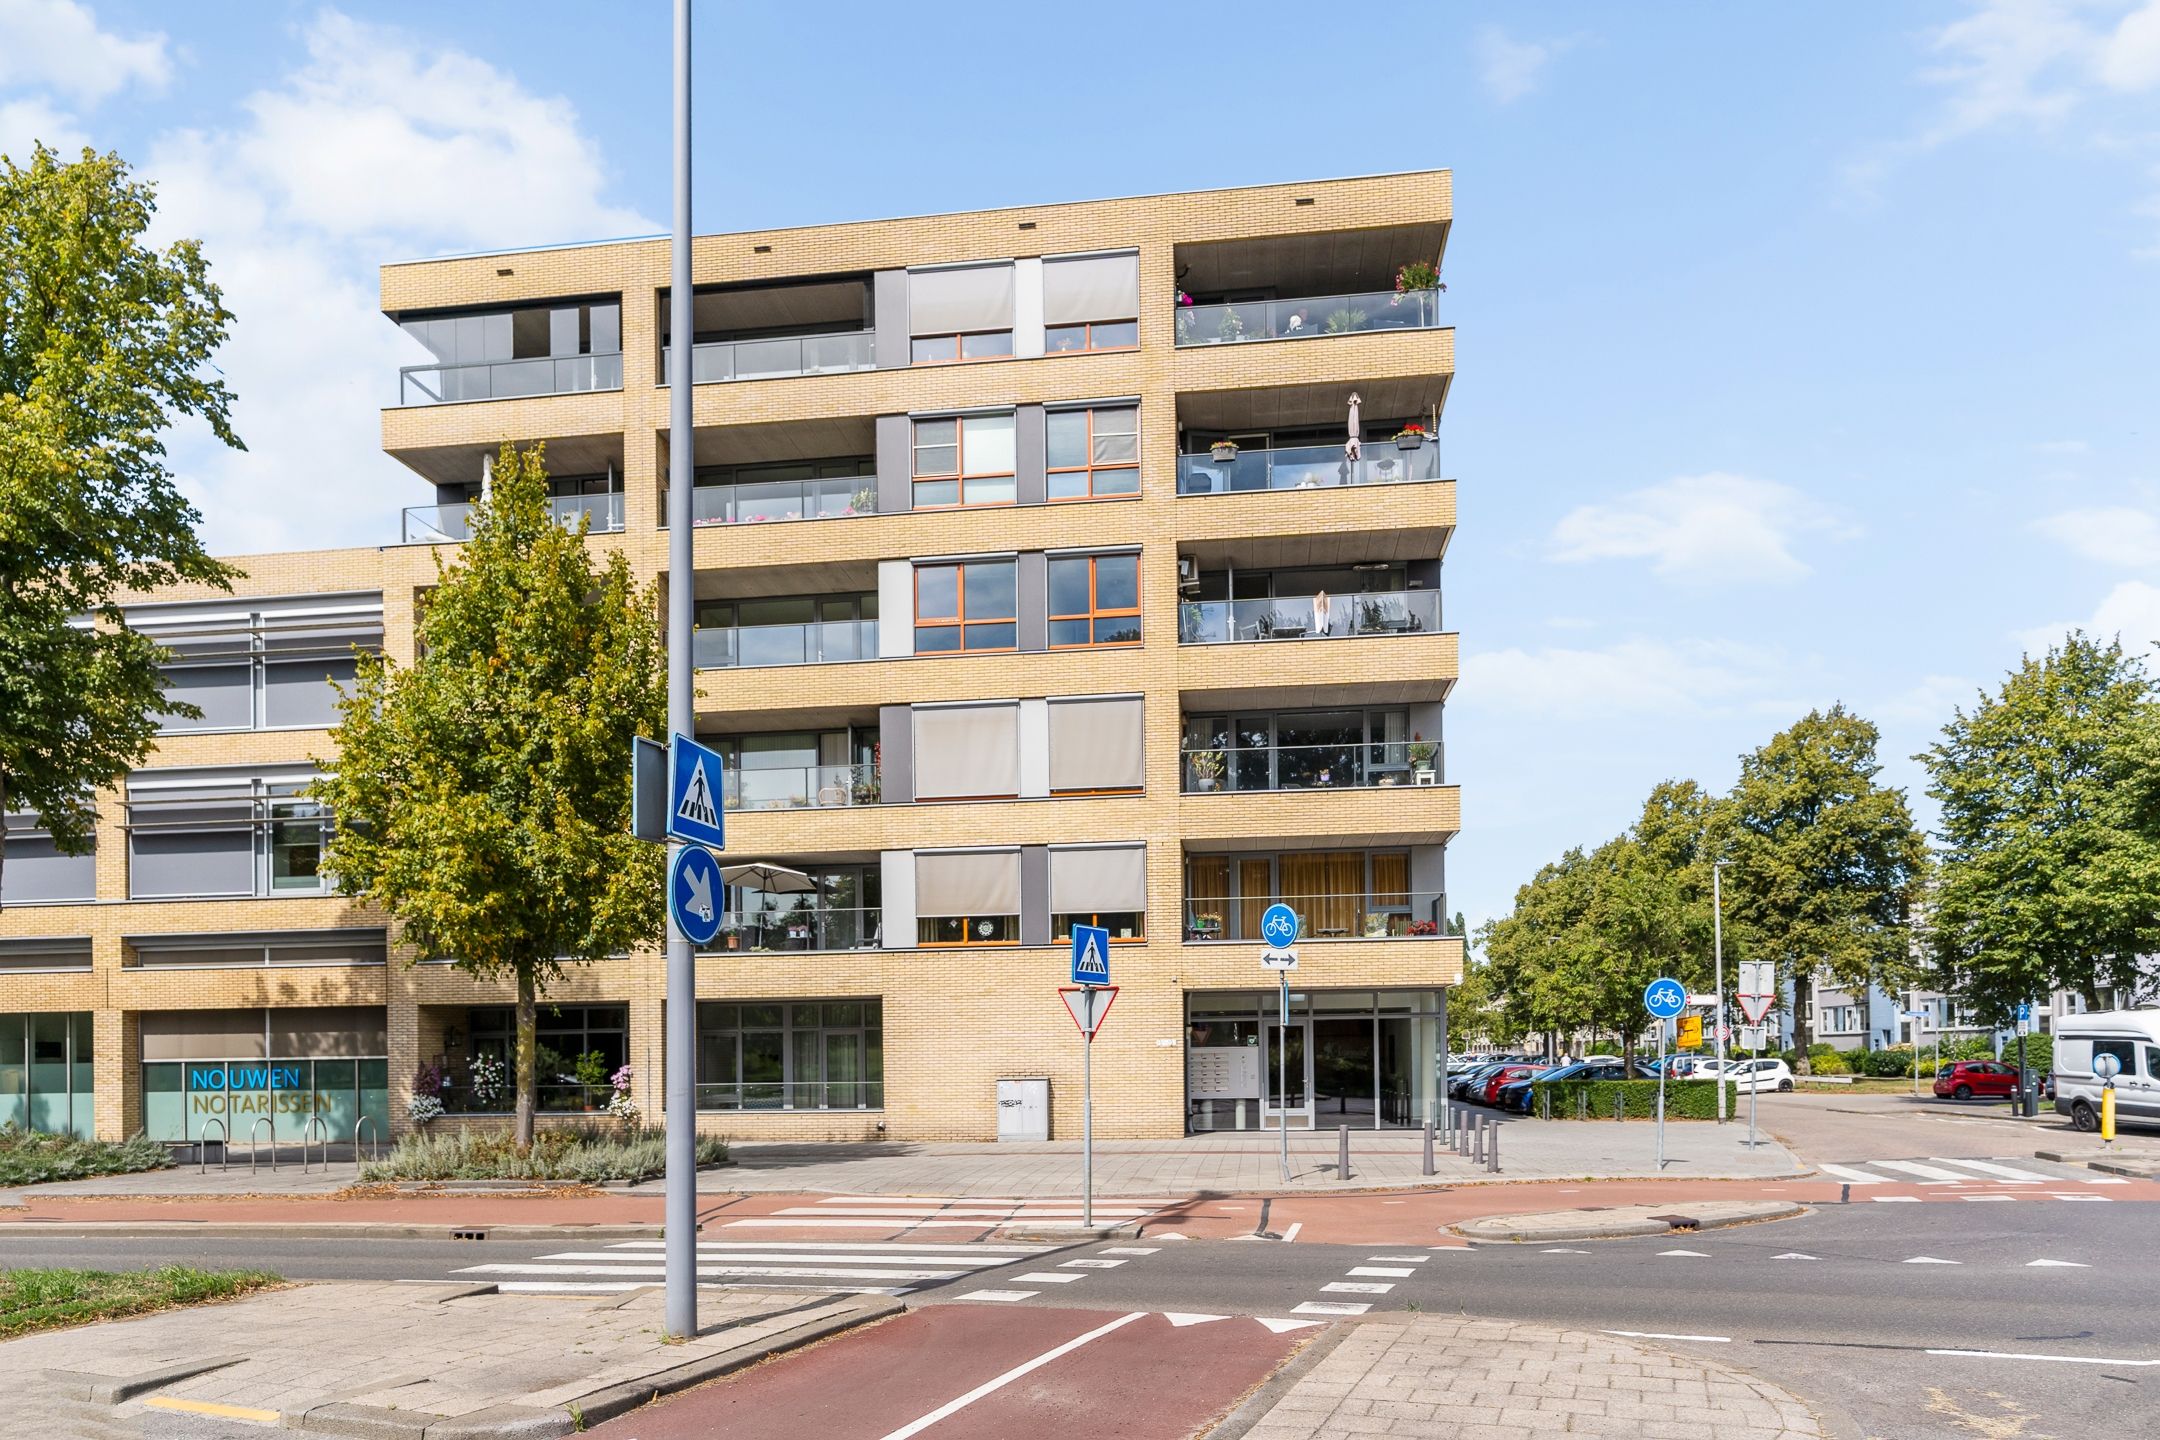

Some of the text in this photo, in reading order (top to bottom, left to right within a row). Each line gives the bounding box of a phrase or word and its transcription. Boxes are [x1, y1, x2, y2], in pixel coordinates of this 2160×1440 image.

[2019, 1006, 2026, 1019] P
[192, 1068, 300, 1089] NOUWEN
[193, 1093, 331, 1114] NOTARISSEN
